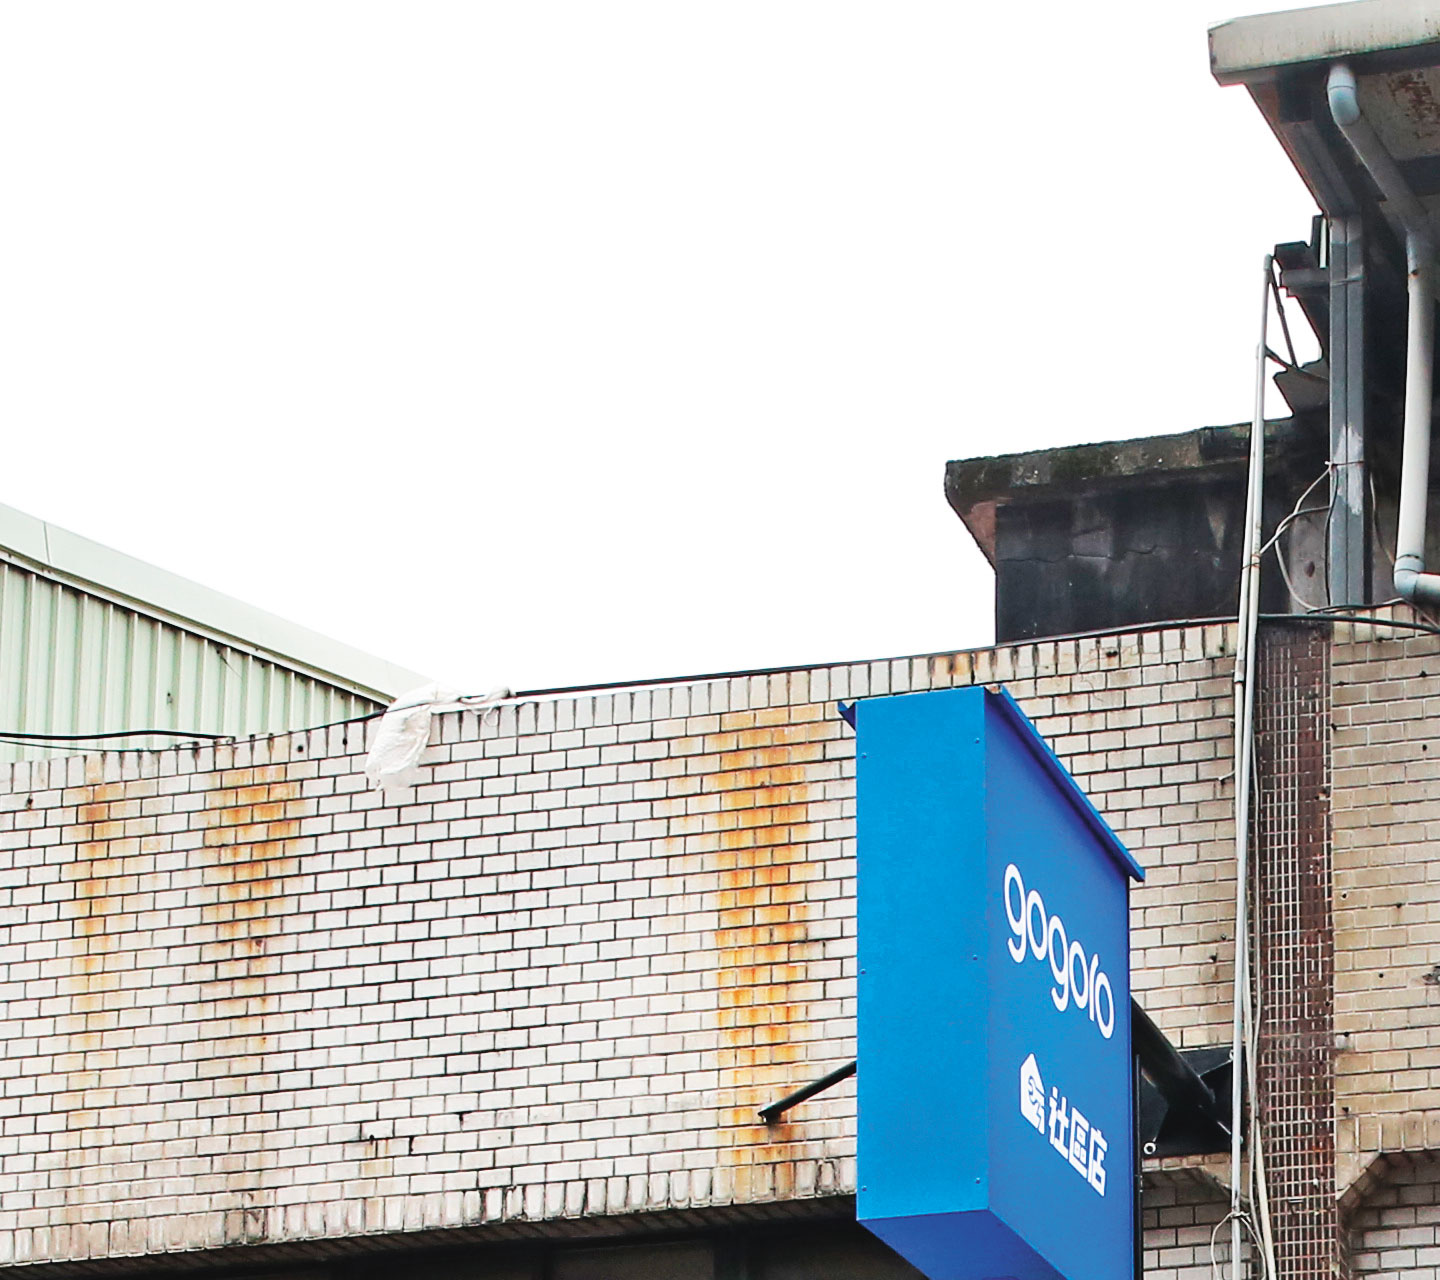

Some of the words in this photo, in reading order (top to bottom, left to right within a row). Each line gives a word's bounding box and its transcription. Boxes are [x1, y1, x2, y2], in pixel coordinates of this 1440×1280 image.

[1003, 863, 1114, 1040] gogoro
[1048, 1085, 1109, 1197] 社區店
